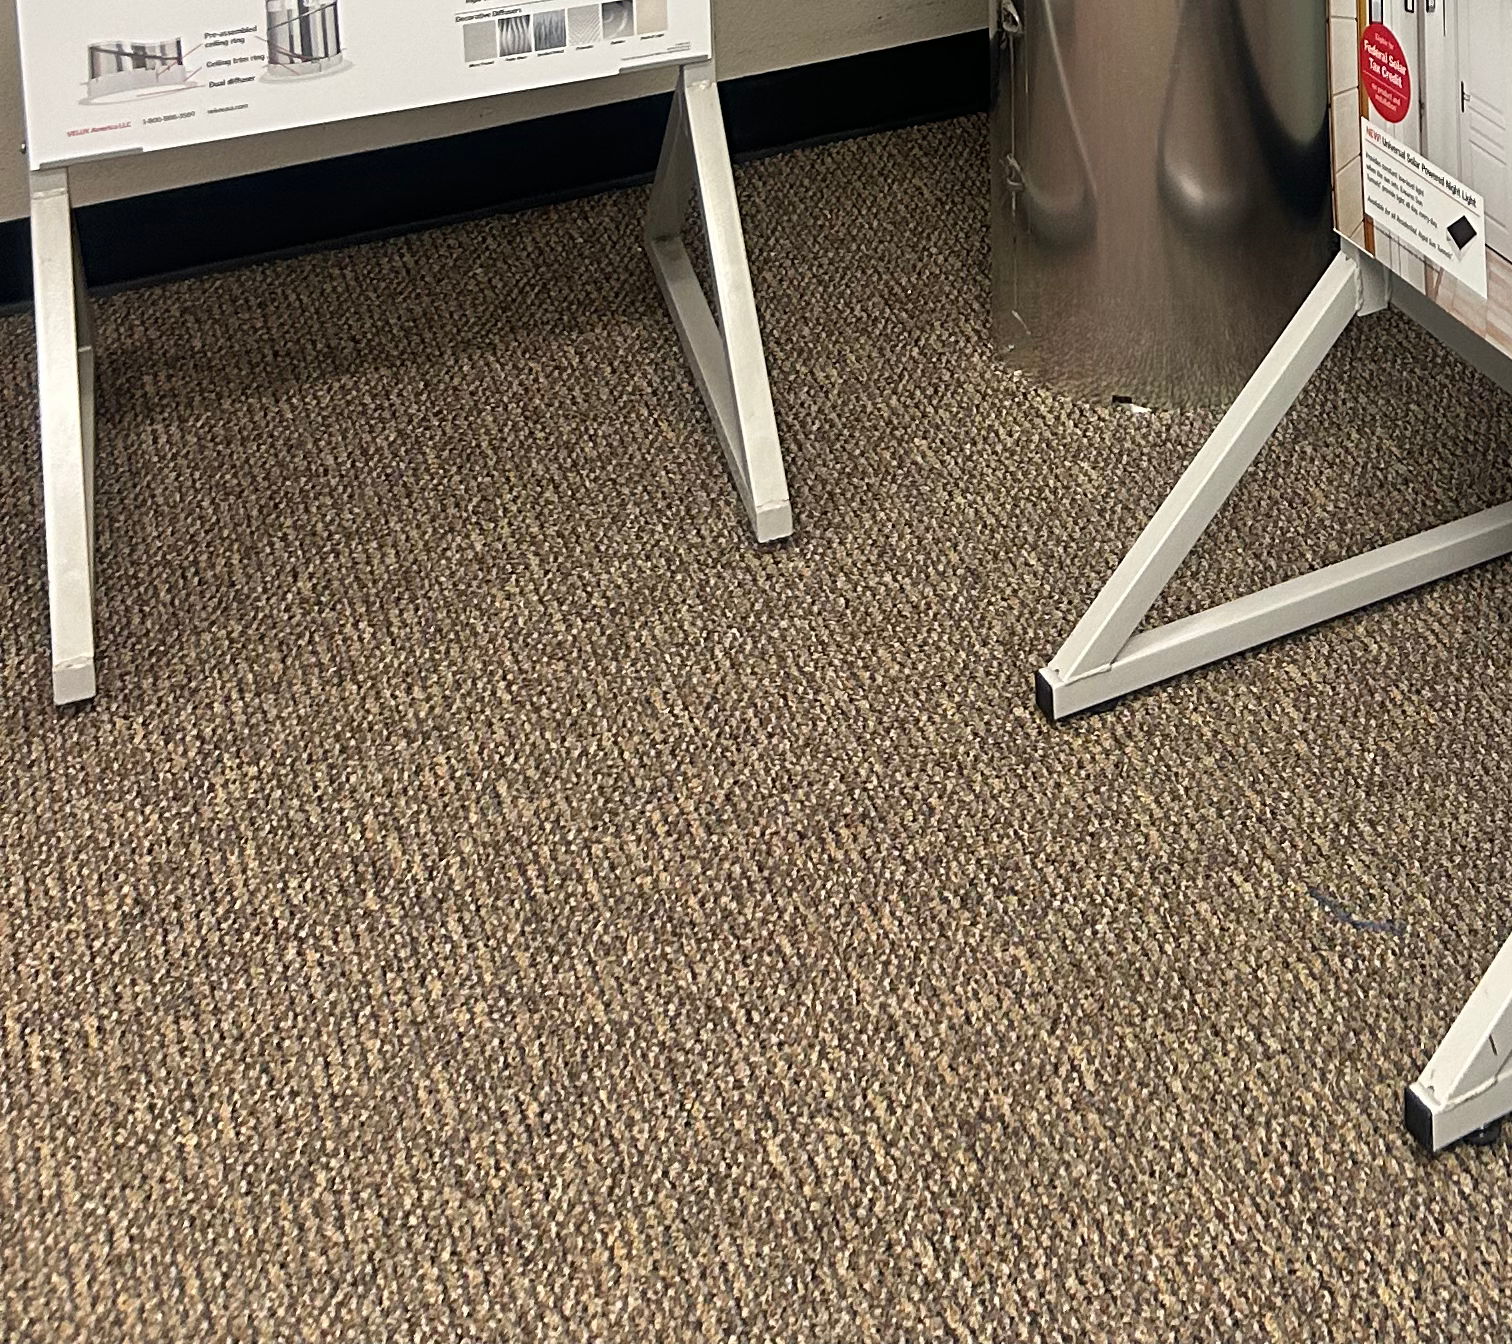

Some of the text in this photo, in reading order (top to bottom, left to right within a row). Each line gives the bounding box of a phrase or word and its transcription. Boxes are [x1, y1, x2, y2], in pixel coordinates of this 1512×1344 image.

[455, 13, 491, 24] Decorative
[204, 25, 258, 39] Pre-assembled
[204, 40, 229, 48] ceiling
[206, 60, 232, 68] Ceiling
[1364, 39, 1407, 76] Federal Solar
[1368, 57, 1402, 89] Tax Credit
[208, 76, 256, 88] Dual diffuser
[1382, 136, 1406, 160] Universal
[1406, 153, 1420, 170] Solar
[1421, 163, 1444, 186] Powered
[1445, 179, 1461, 198] Night
[1461, 189, 1476, 208] Light
